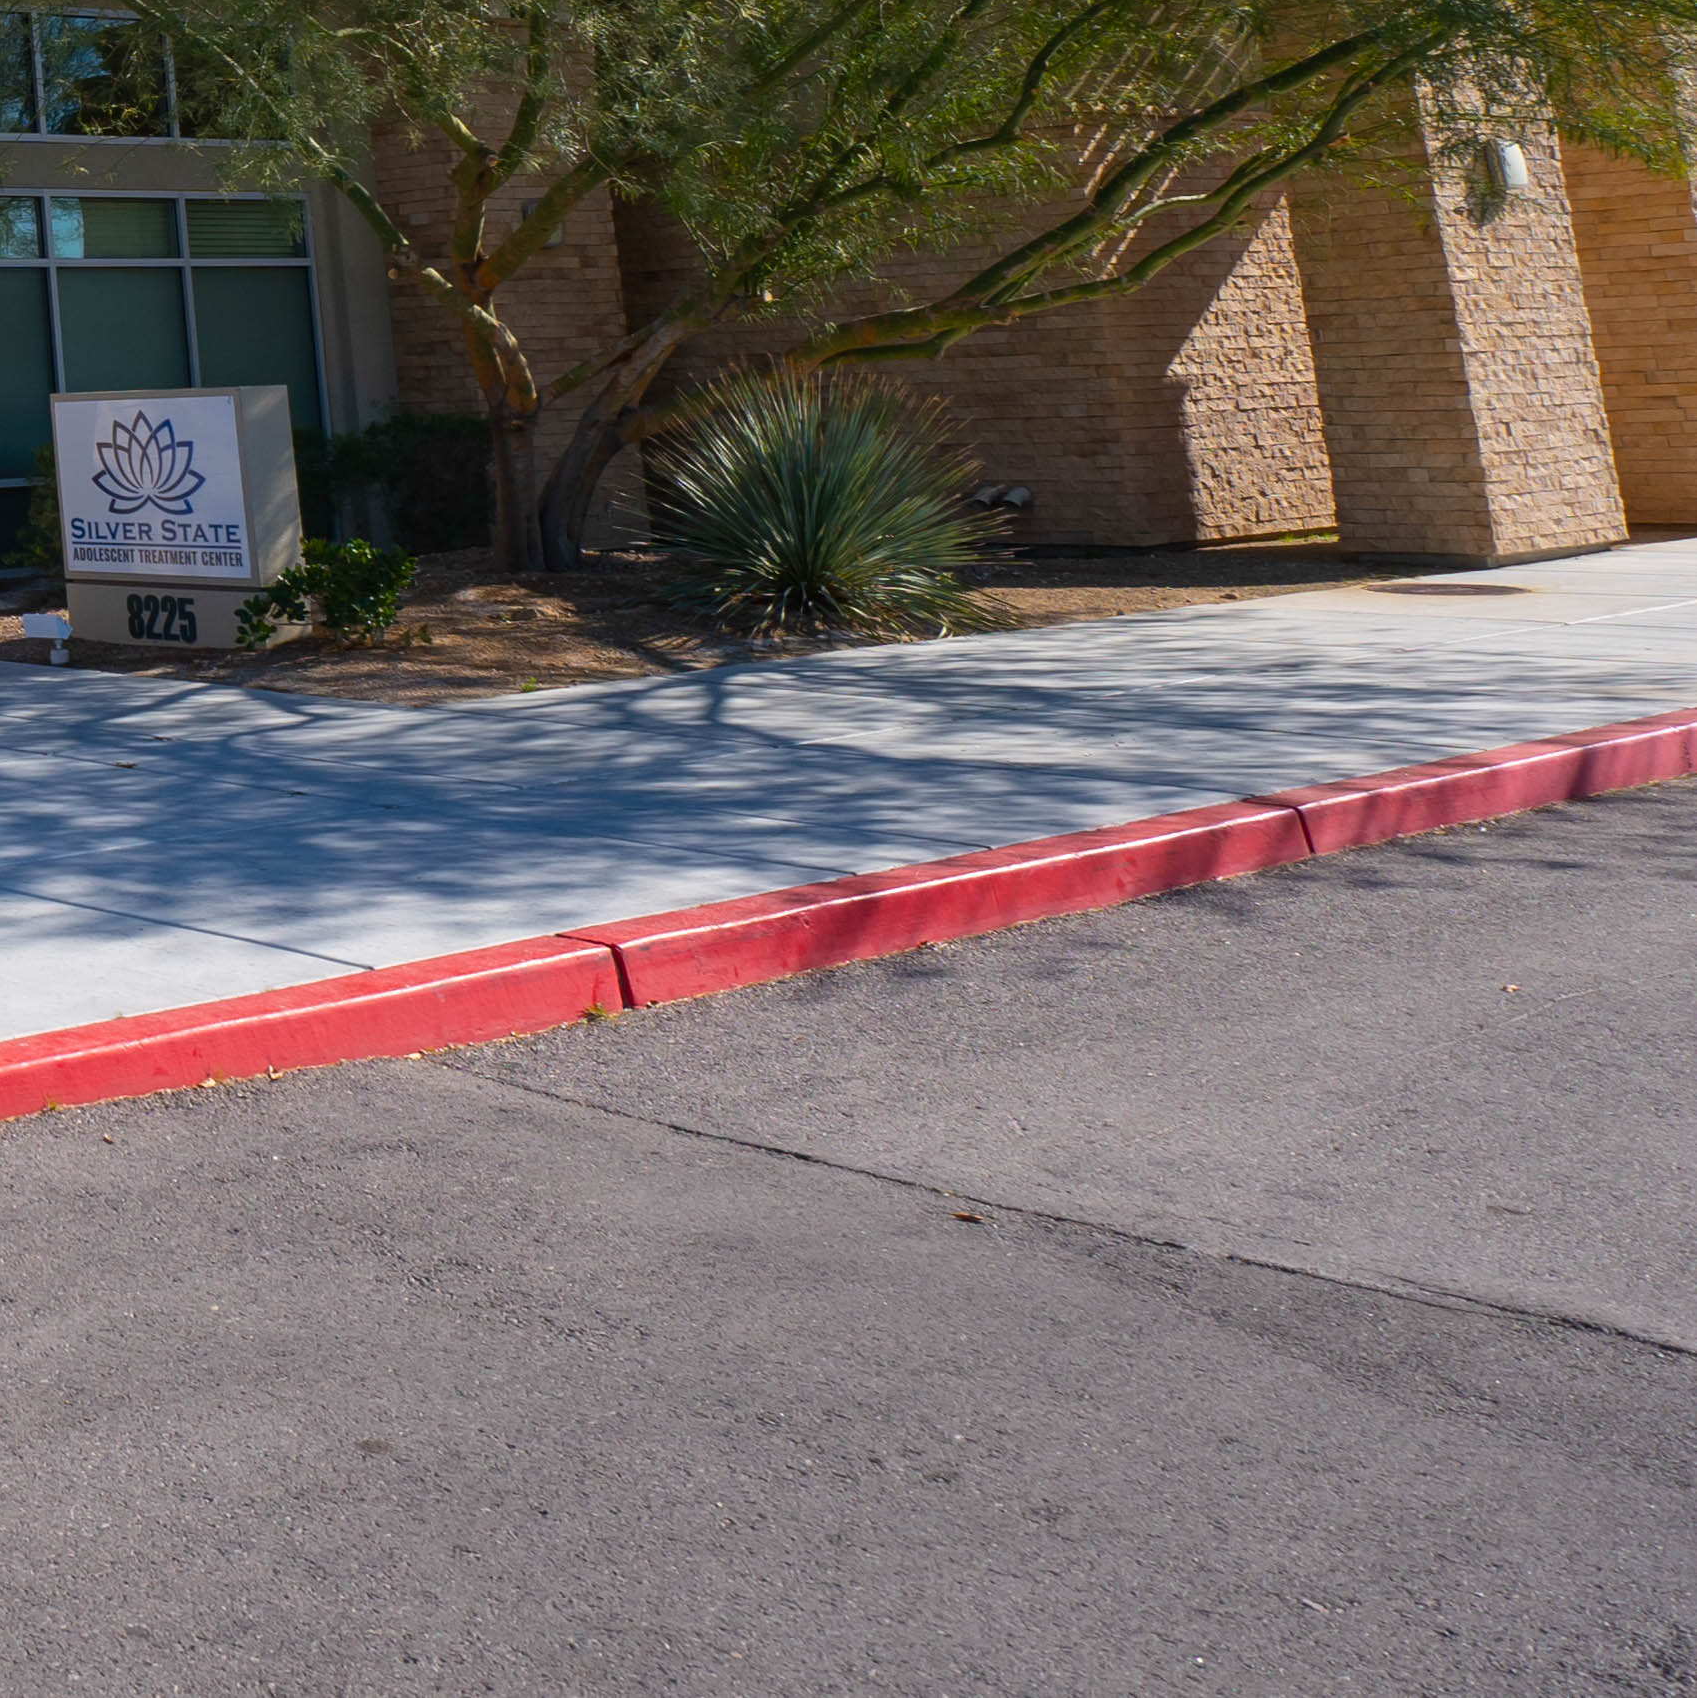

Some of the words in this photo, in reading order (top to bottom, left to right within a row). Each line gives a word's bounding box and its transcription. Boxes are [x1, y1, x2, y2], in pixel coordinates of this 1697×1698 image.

[70, 517, 153, 541] SILVER
[161, 519, 241, 544] STATE
[73, 547, 135, 563] ADOLESCENT
[139, 549, 197, 566] TREATMENT
[201, 551, 244, 567] CENTER
[126, 593, 198, 644] 8225
